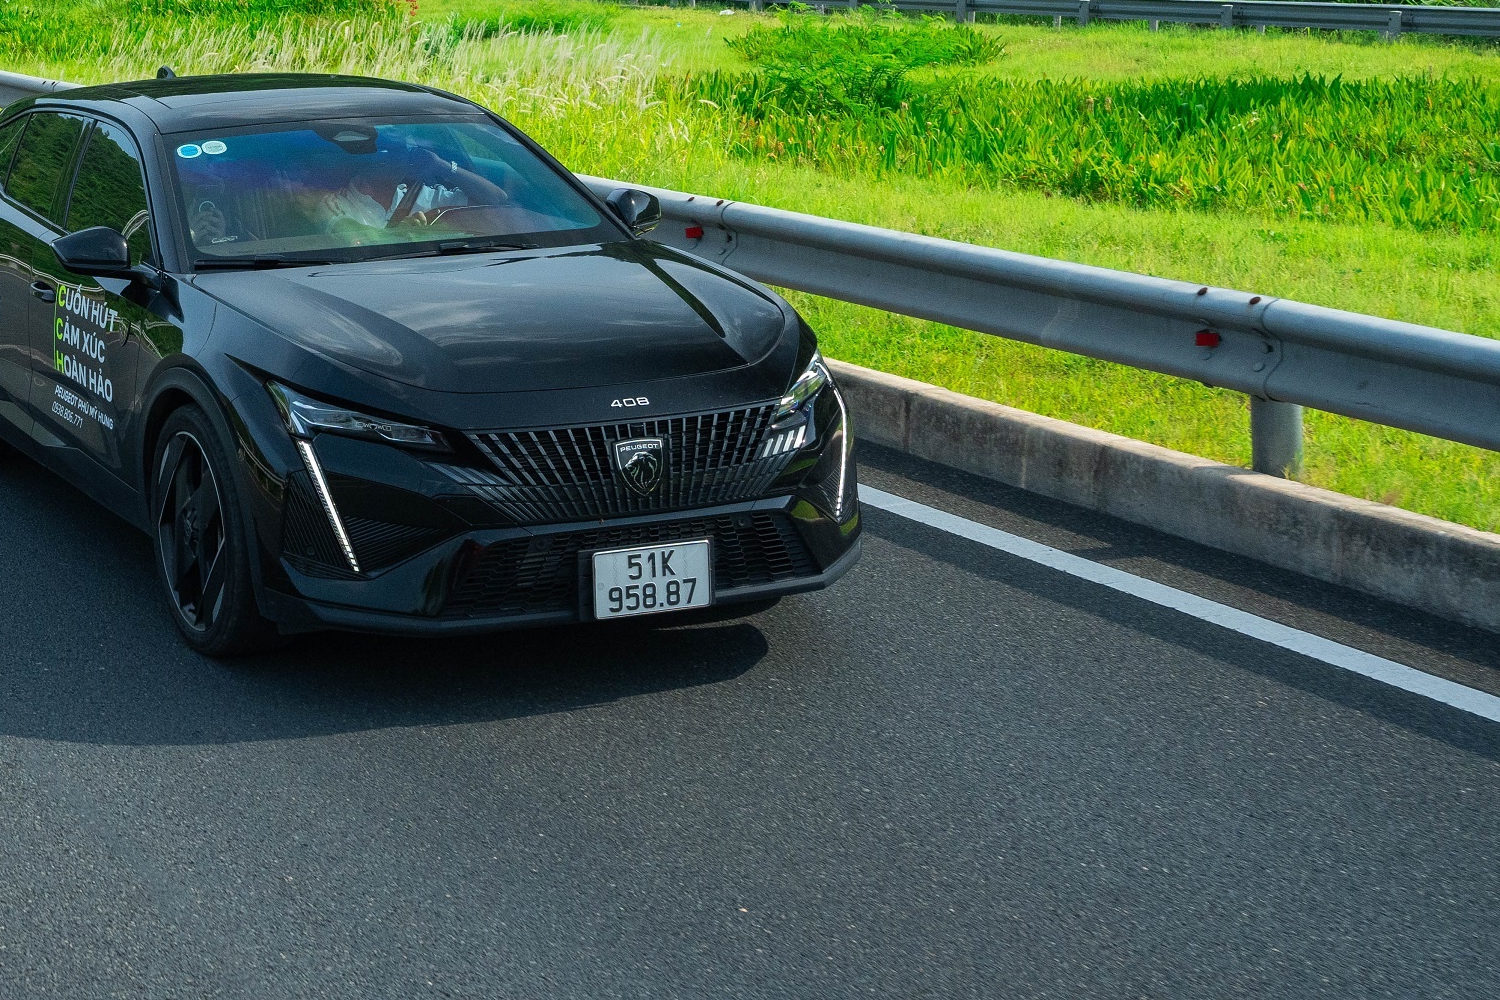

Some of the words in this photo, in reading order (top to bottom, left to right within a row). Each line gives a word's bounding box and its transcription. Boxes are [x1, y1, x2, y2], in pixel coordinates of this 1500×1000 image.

[58, 284, 90, 320] CUỐN
[90, 301, 118, 332] HÚT
[56, 315, 80, 350] CẢM
[82, 332, 105, 363] XÚC
[56, 350, 87, 387] HOÀN
[89, 368, 113, 402] HẢO
[54, 384, 79, 407] PEUGEOT
[610, 397, 650, 408] 408
[619, 443, 659, 453] PEUGEOT
[627, 549, 676, 581] 51K
[608, 577, 697, 613] 958.87
